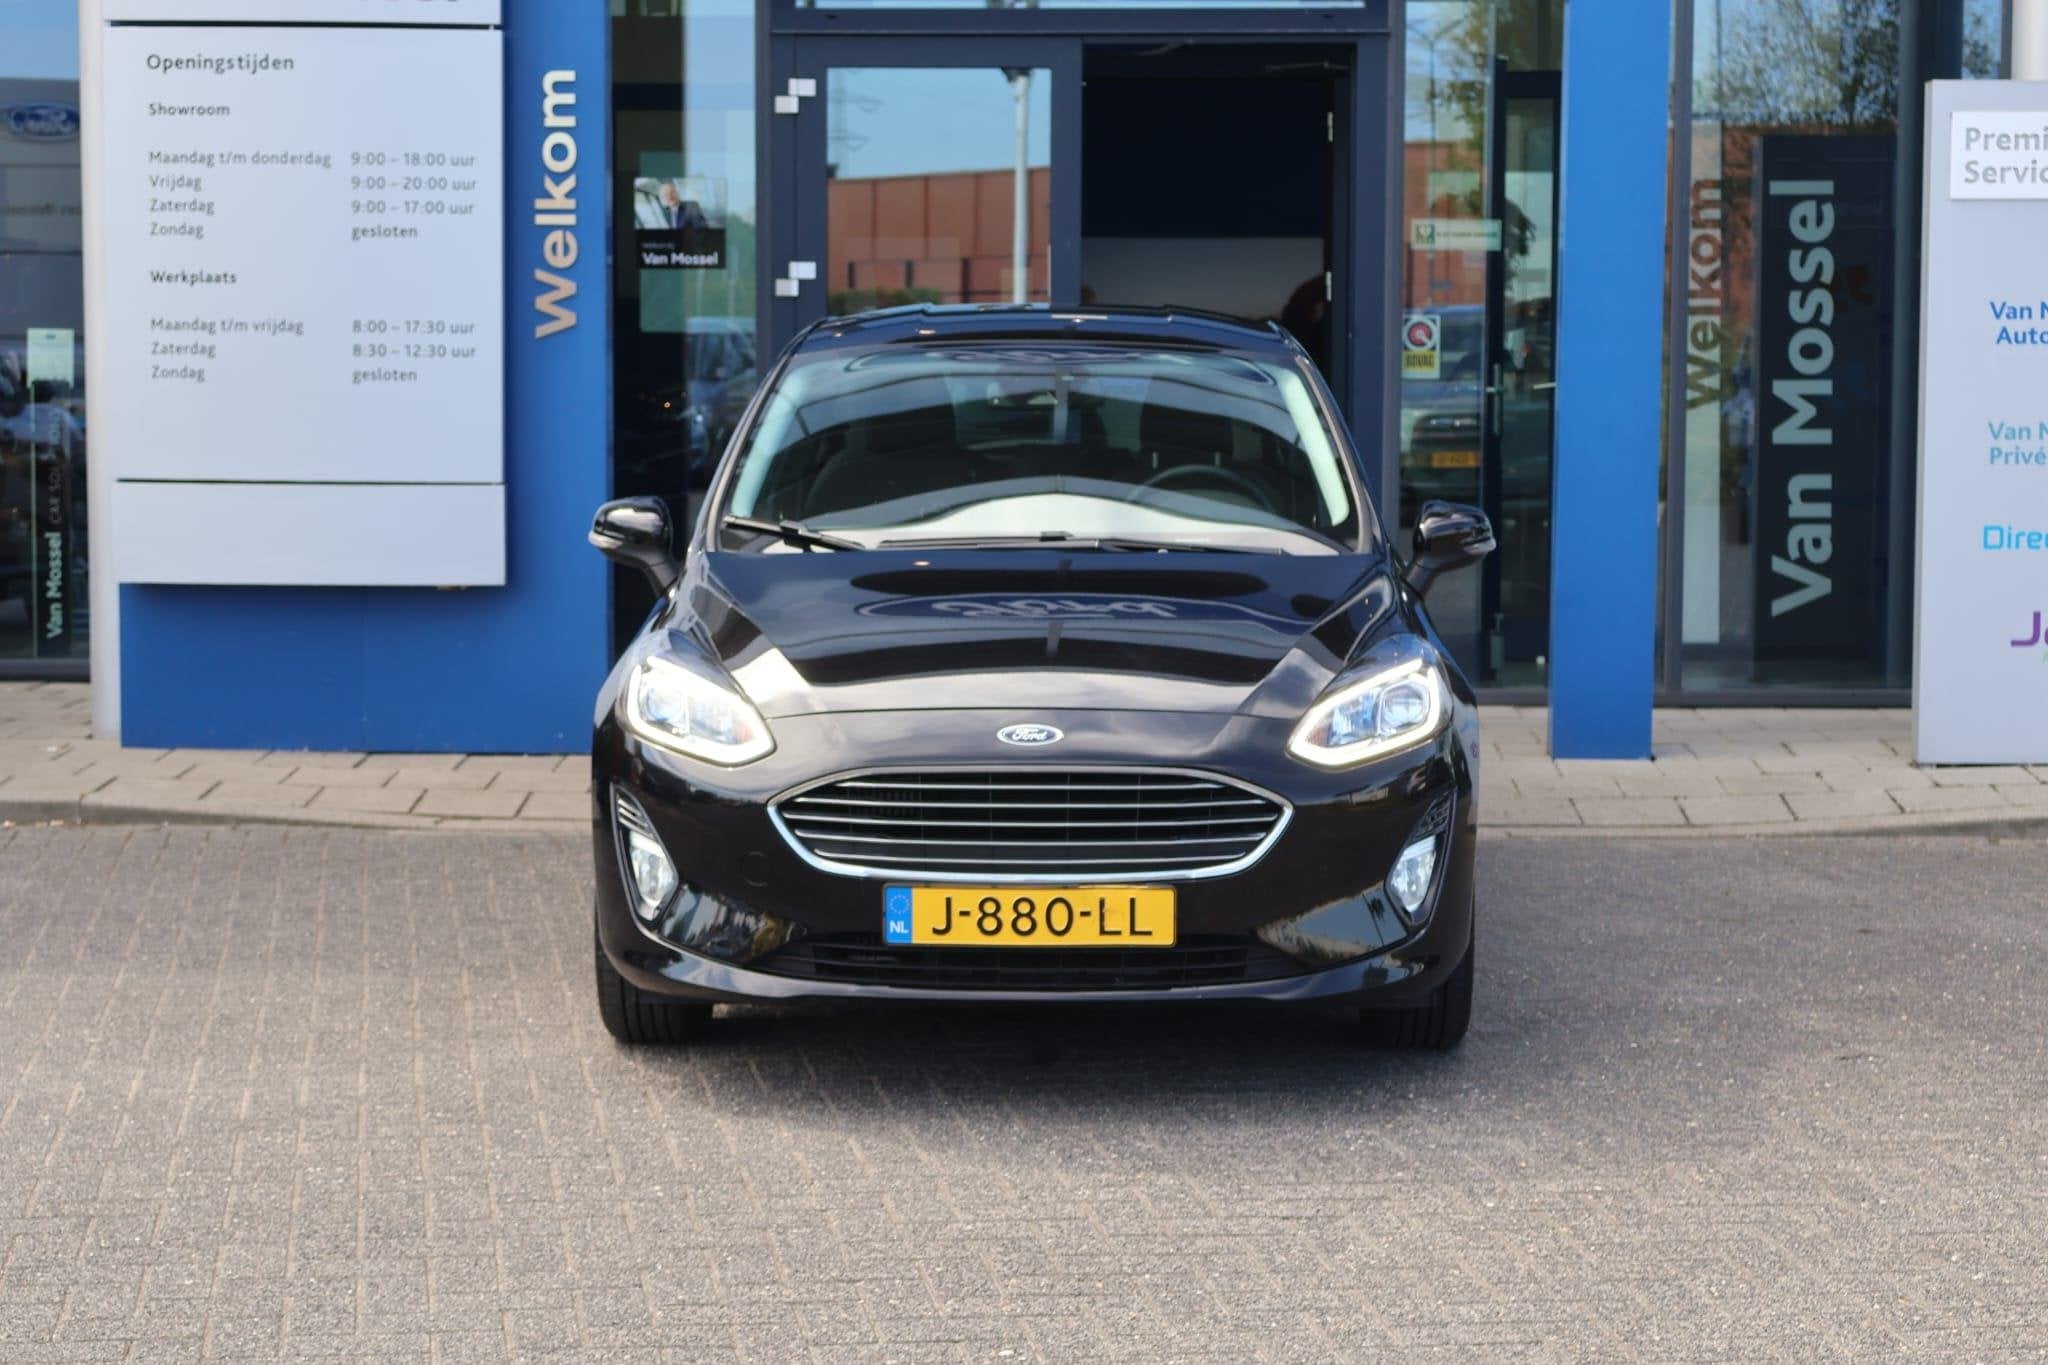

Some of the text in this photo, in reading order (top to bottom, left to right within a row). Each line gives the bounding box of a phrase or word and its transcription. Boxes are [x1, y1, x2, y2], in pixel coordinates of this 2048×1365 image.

[147, 54, 295, 74] Openingstijden
[149, 103, 231, 116] Showroom
[149, 151, 332, 169] Maandag t/m donderdag
[351, 152, 386, 166] 9:00
[403, 152, 446, 166] 18:00
[450, 156, 475, 166] uur
[149, 175, 202, 192] Vrijdag
[351, 176, 386, 190] 9:00
[403, 176, 447, 190] 20:00
[452, 180, 476, 190] uur
[150, 199, 215, 215] Zaterdag
[351, 200, 386, 214] 9:00
[403, 200, 445, 214] 17:00
[450, 204, 474, 214] uur
[534, 69, 578, 338] Welkom
[150, 222, 204, 239] Zondag
[352, 225, 418, 241] gesloten
[643, 253, 718, 265] Van Mossel
[150, 271, 237, 287] Werkplaats
[1686, 180, 1723, 409] Welkom
[1989, 301, 2033, 320] Van
[151, 318, 304, 335] Maandag t/m vrijdag
[352, 320, 387, 333] 8:00
[404, 320, 446, 334] 17:30
[450, 323, 474, 334] uur
[151, 341, 216, 359] Zaterdag
[352, 344, 387, 357] 8:30
[404, 344, 447, 358] 12:30
[451, 347, 475, 358] uur
[151, 365, 205, 383] Zondag
[352, 368, 418, 384] gesloten
[1769, 180, 1835, 617] Van Mossel
[1988, 421, 2031, 440] Van
[1990, 445, 2047, 465] Privé
[1983, 525, 2048, 550] Dire
[45, 532, 62, 598] Mossel
[46, 602, 62, 639] Van
[931, 896, 1153, 937] J-880-LL
[889, 921, 909, 934] NL
